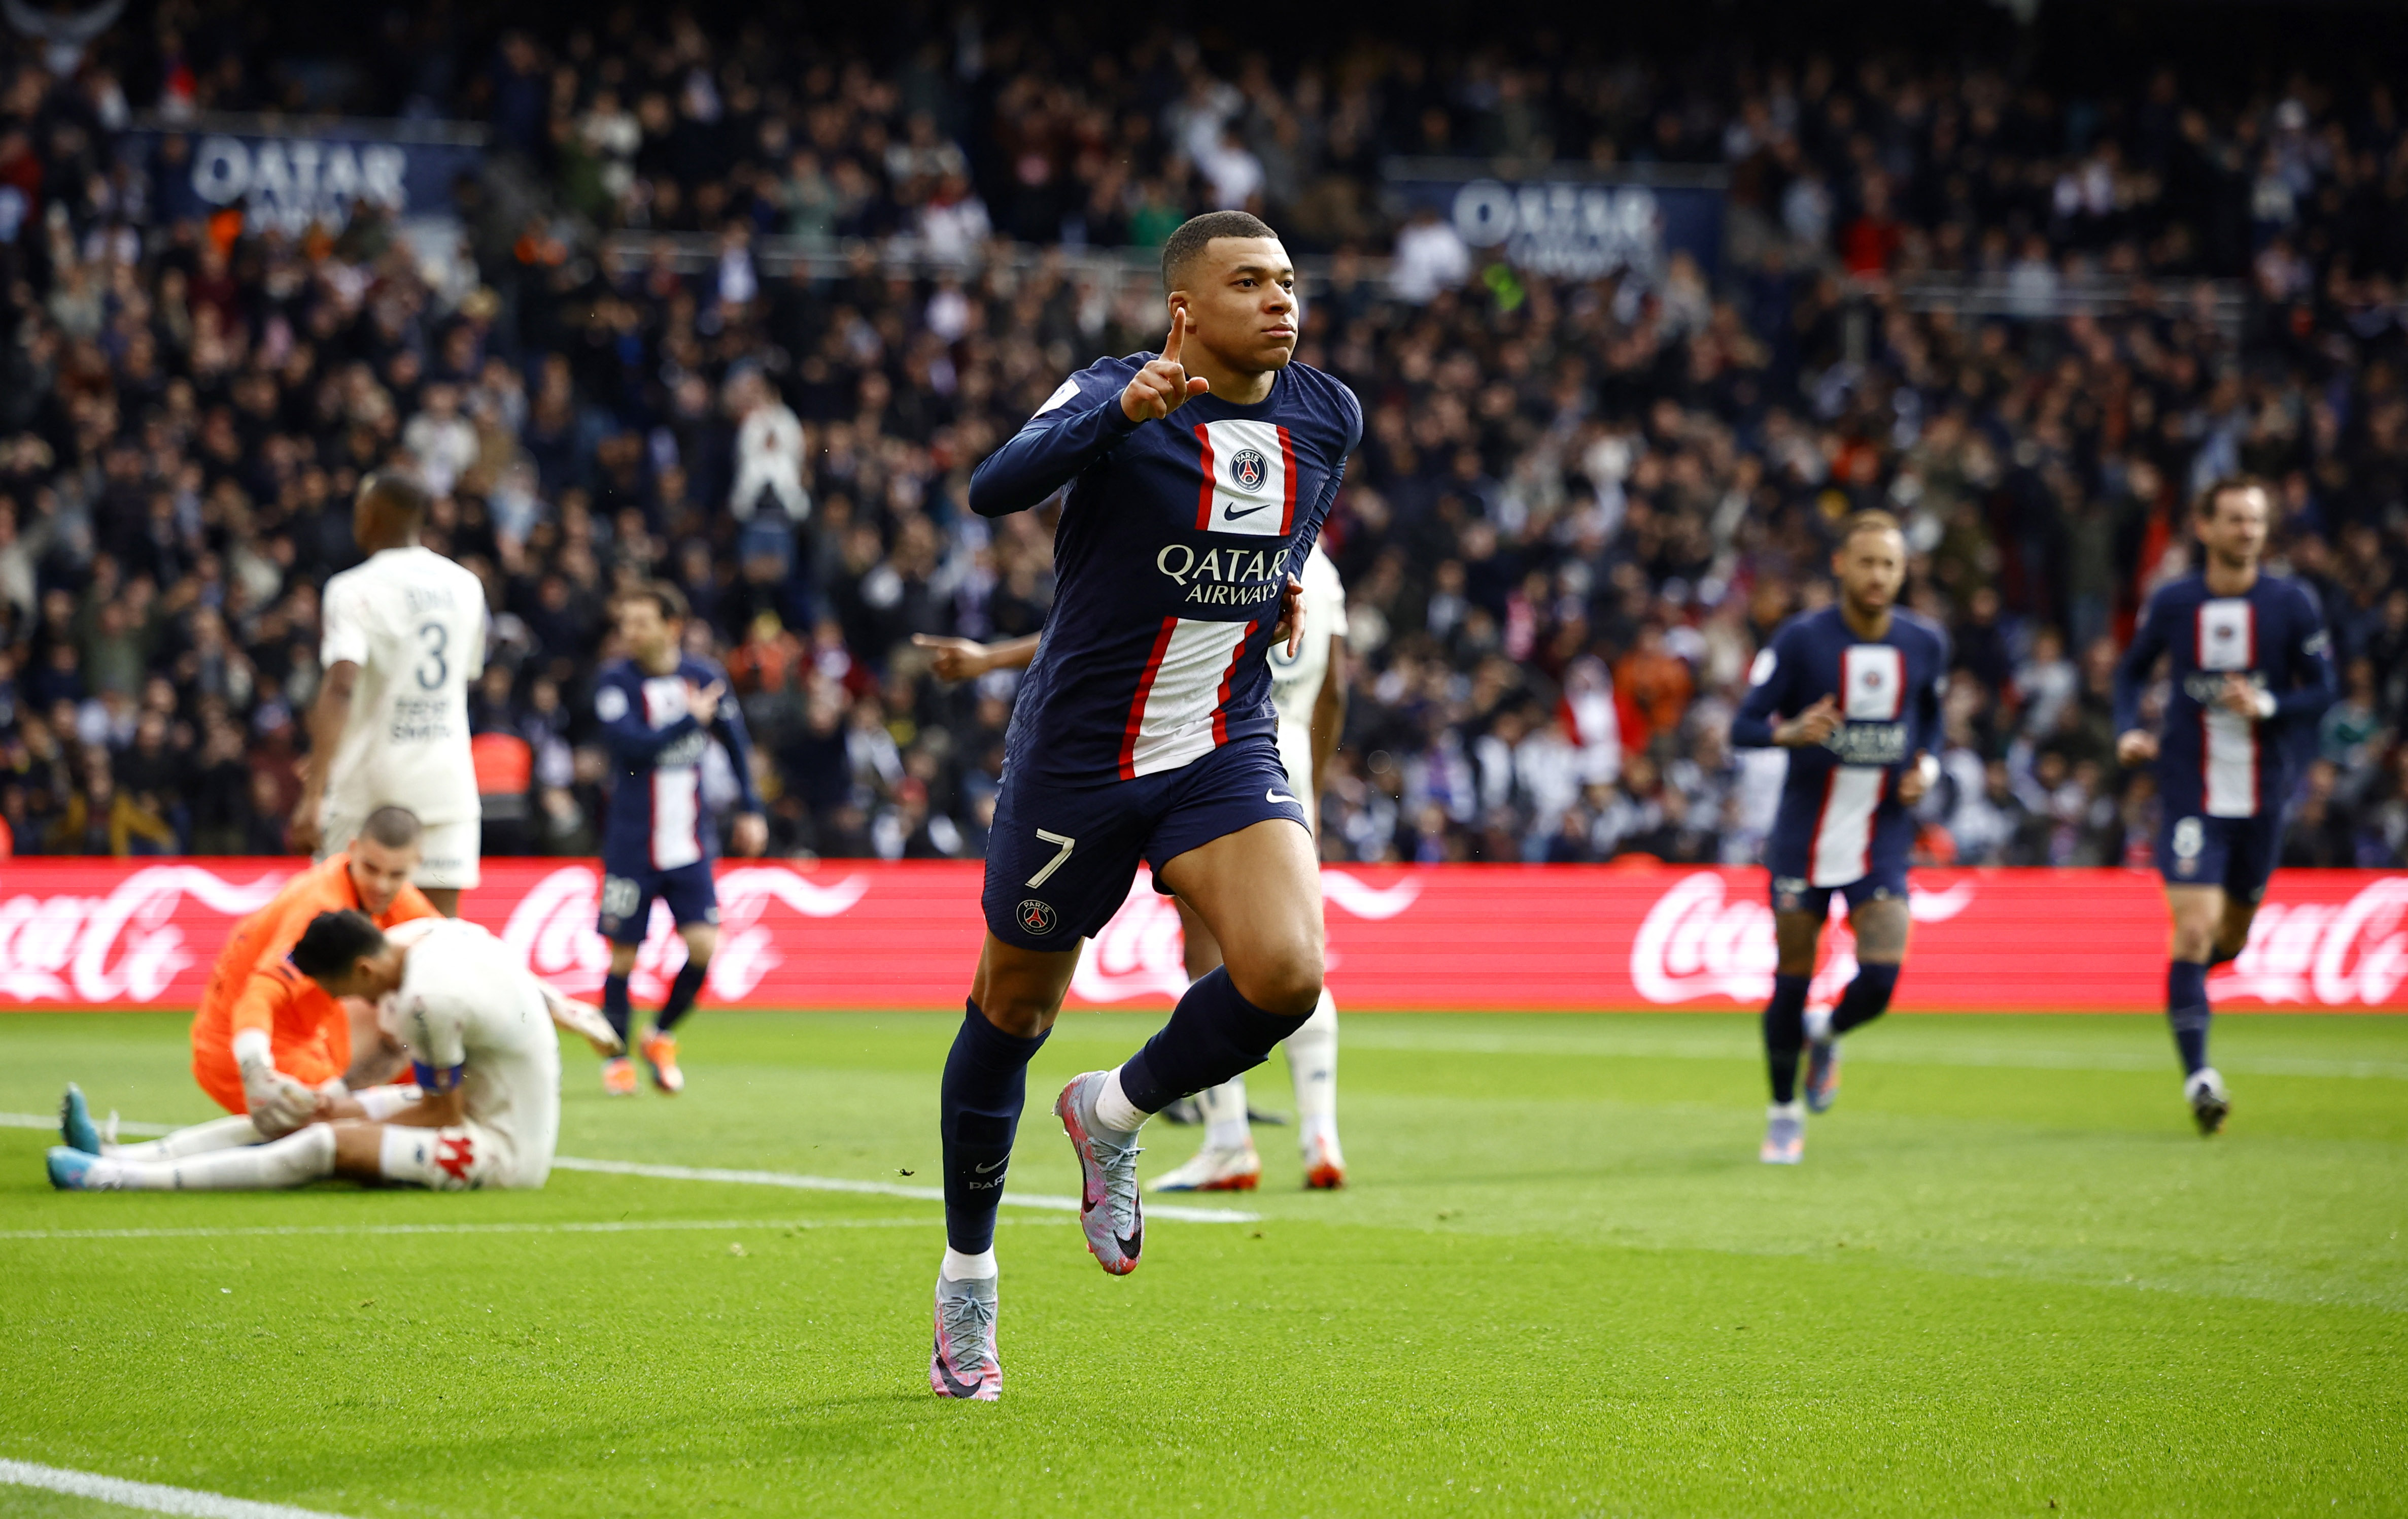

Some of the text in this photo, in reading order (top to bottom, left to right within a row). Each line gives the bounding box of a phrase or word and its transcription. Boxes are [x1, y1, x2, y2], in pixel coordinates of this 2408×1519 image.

[1235, 452, 1260, 464] PARIS
[1157, 544, 1289, 586] QATAR
[1185, 580, 1278, 605] AIRWAYS
[416, 620, 448, 691] 3
[1025, 828, 1075, 889] 7
[1023, 901, 1050, 913] PARIS
